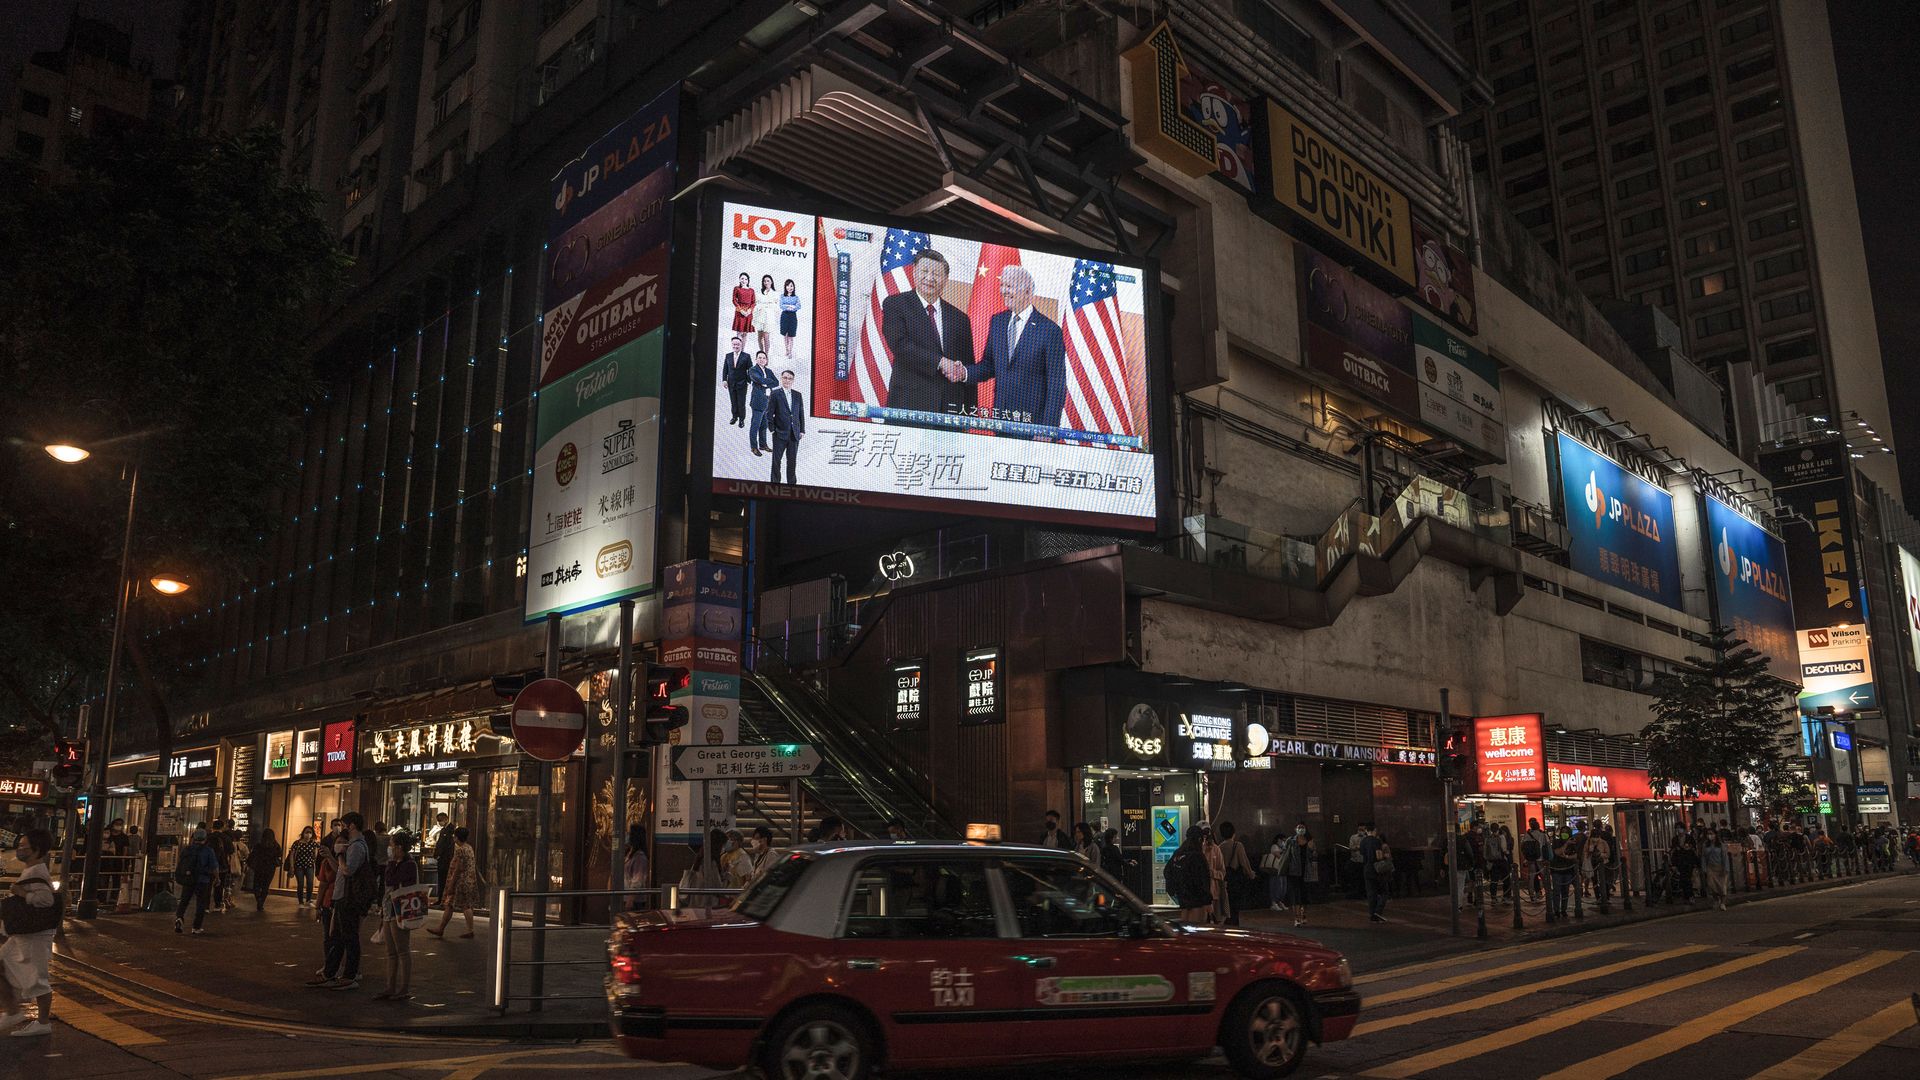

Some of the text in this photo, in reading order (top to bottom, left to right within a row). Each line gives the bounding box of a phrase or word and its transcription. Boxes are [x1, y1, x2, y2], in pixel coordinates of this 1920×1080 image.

[577, 114, 671, 197] JP PLAZA
[1291, 124, 1338, 182] DON
[596, 196, 665, 249] CINEMA CITY
[1294, 159, 1396, 267] DONKI
[733, 213, 807, 247] HOY TV
[576, 283, 658, 344] OUTBACK
[1343, 358, 1391, 393] OUTBACK
[948, 402, 1033, 424] 二人之後正式會談
[603, 429, 635, 458] SUPER
[1784, 459, 1833, 473] THE PARK LANE
[729, 483, 860, 503] JM NETWORK
[1609, 496, 1661, 542] JP PLAZA
[1814, 500, 1850, 608] IKEA
[1741, 556, 1787, 602] JP PLAZA
[700, 586, 710, 595] JP
[1831, 630, 1860, 638] Wilson
[664, 651, 692, 663] OUTBACK
[697, 651, 738, 664] OUTBACK
[983, 669, 993, 680] JP
[1805, 662, 1862, 675] DECATHLON
[910, 678, 920, 688] JP
[1178, 713, 1232, 741] EXCHANGE
[1192, 715, 1232, 727] HONG KONG
[1488, 726, 1526, 747] 惠康
[327, 750, 347, 762] TUDOR
[697, 748, 801, 760] Great George Street
[1272, 740, 1389, 762] PEARL CITY MANSION
[1485, 748, 1534, 759] wellcome
[169, 757, 187, 778] 大福
[272, 758, 289, 768] ROLEX
[716, 762, 784, 775] 記利佐治街
[789, 763, 810, 771] 25-29
[1243, 759, 1271, 769] CHANGE
[1486, 770, 1504, 783] 24
[1504, 768, 1536, 778] 小時營業
[1561, 769, 1609, 793] wellcome
[14, 782, 41, 795] FULL
[930, 967, 974, 986] 的士
[930, 987, 975, 1007] TAXI
